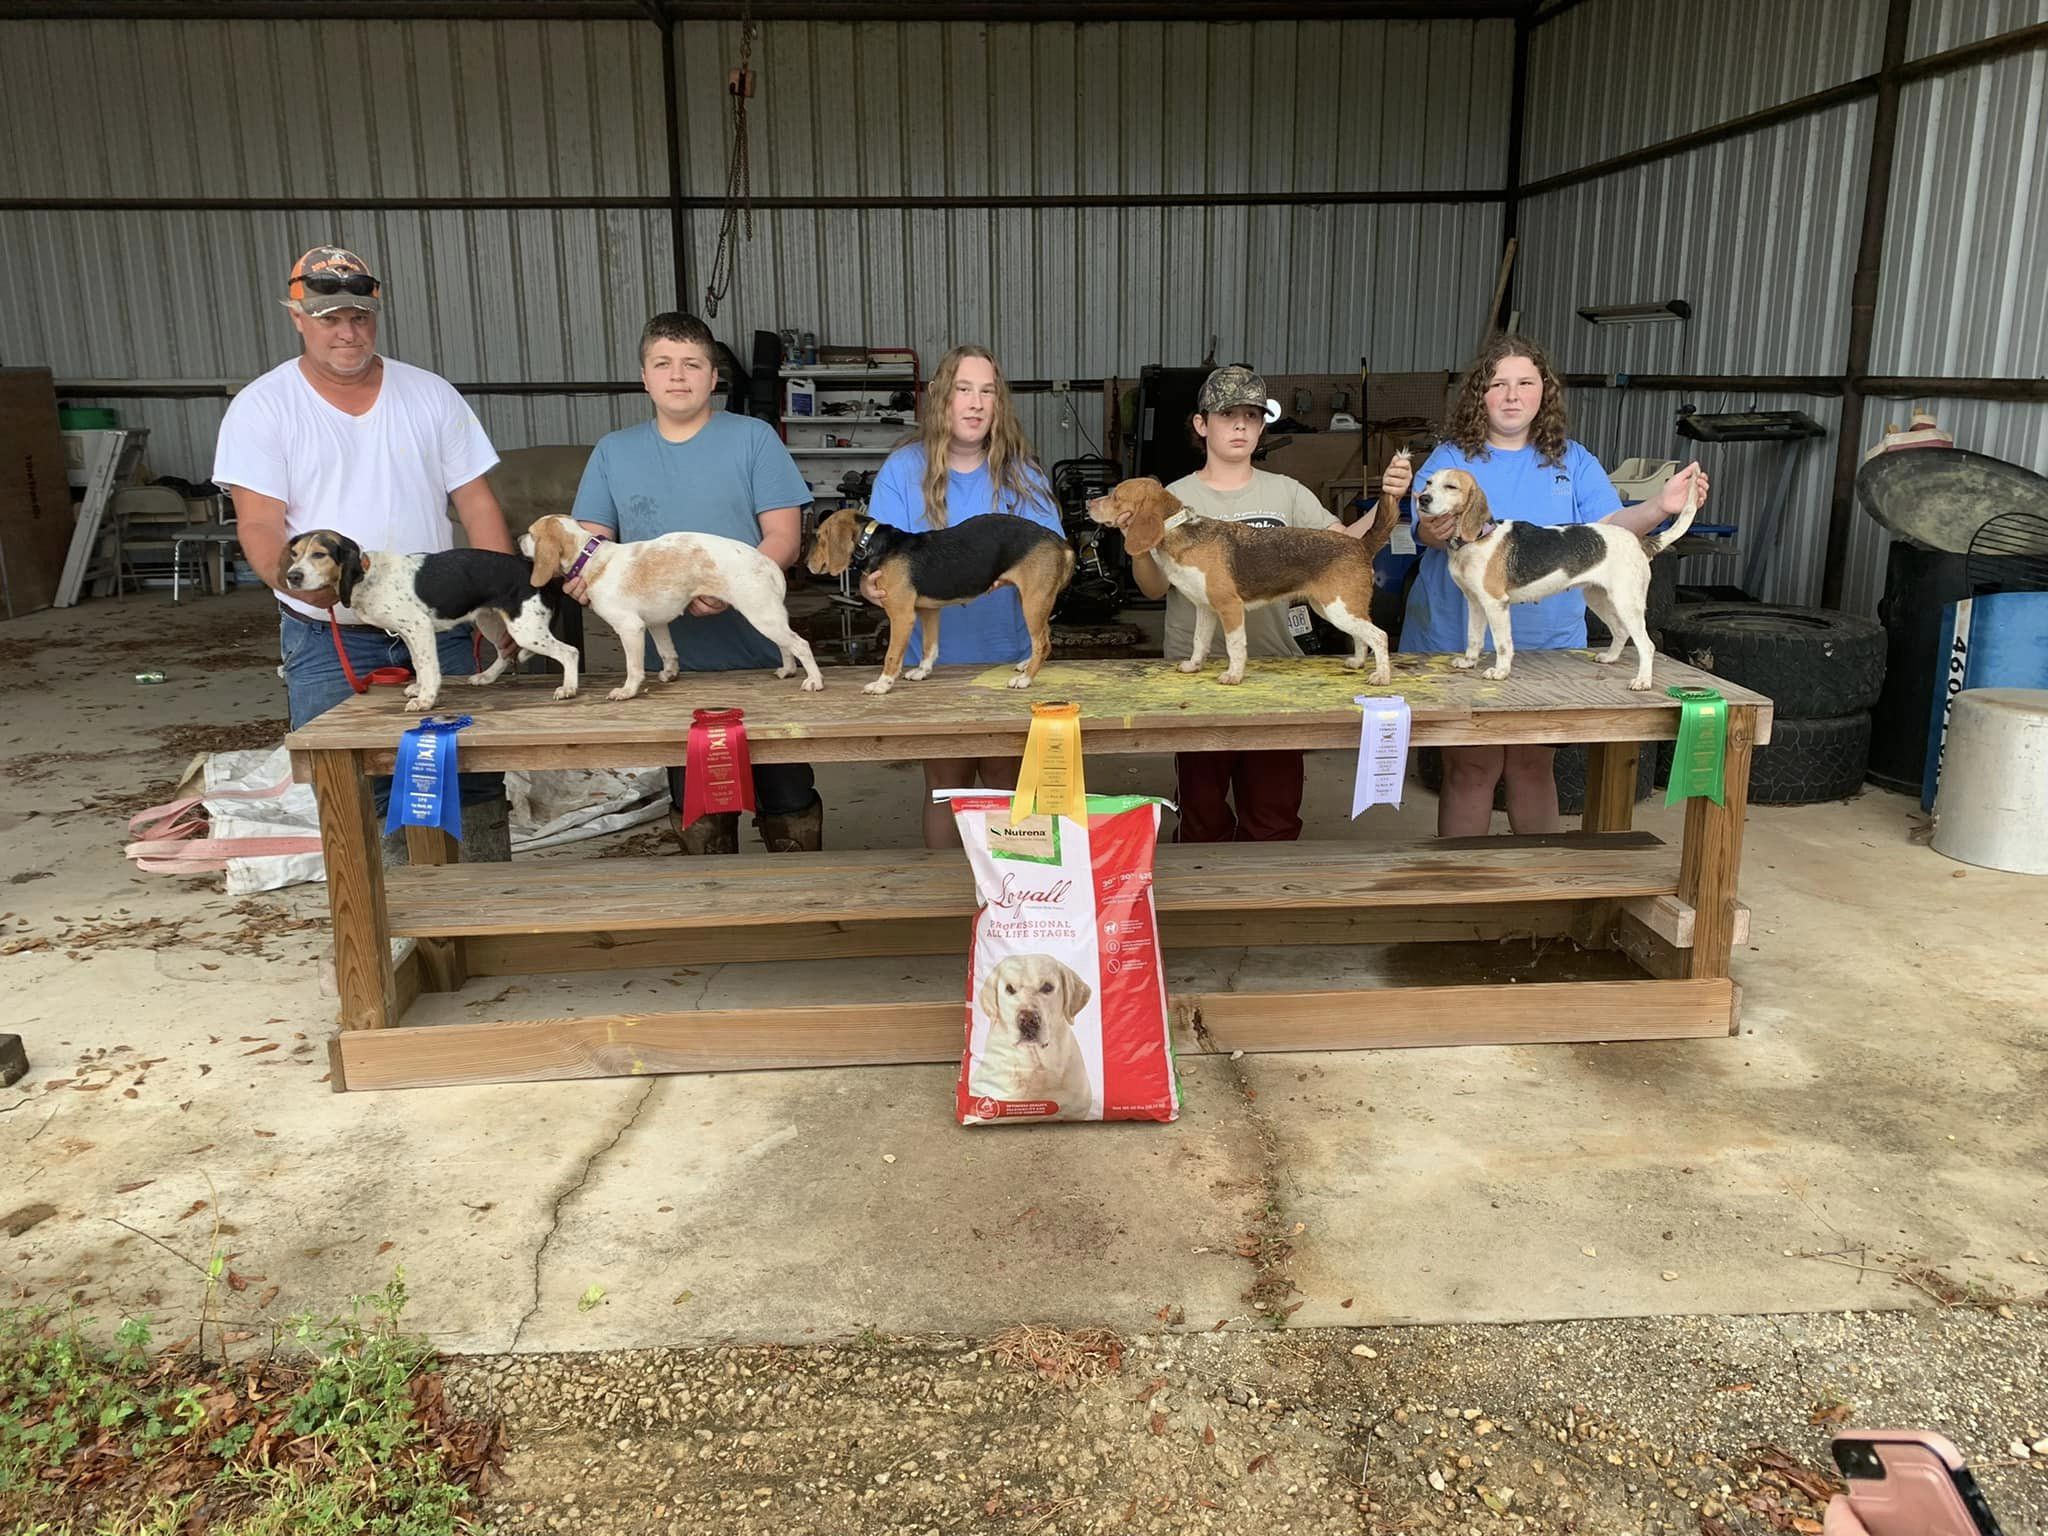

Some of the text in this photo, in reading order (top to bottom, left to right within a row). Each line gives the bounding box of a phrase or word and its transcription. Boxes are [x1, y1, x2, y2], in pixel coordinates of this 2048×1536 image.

[1004, 827, 1046, 837] Nutrena
[988, 872, 1072, 919] Loyall
[990, 919, 1072, 931] PROFESSIONAL
[986, 929, 1077, 939] ALL LIFE STAGES
